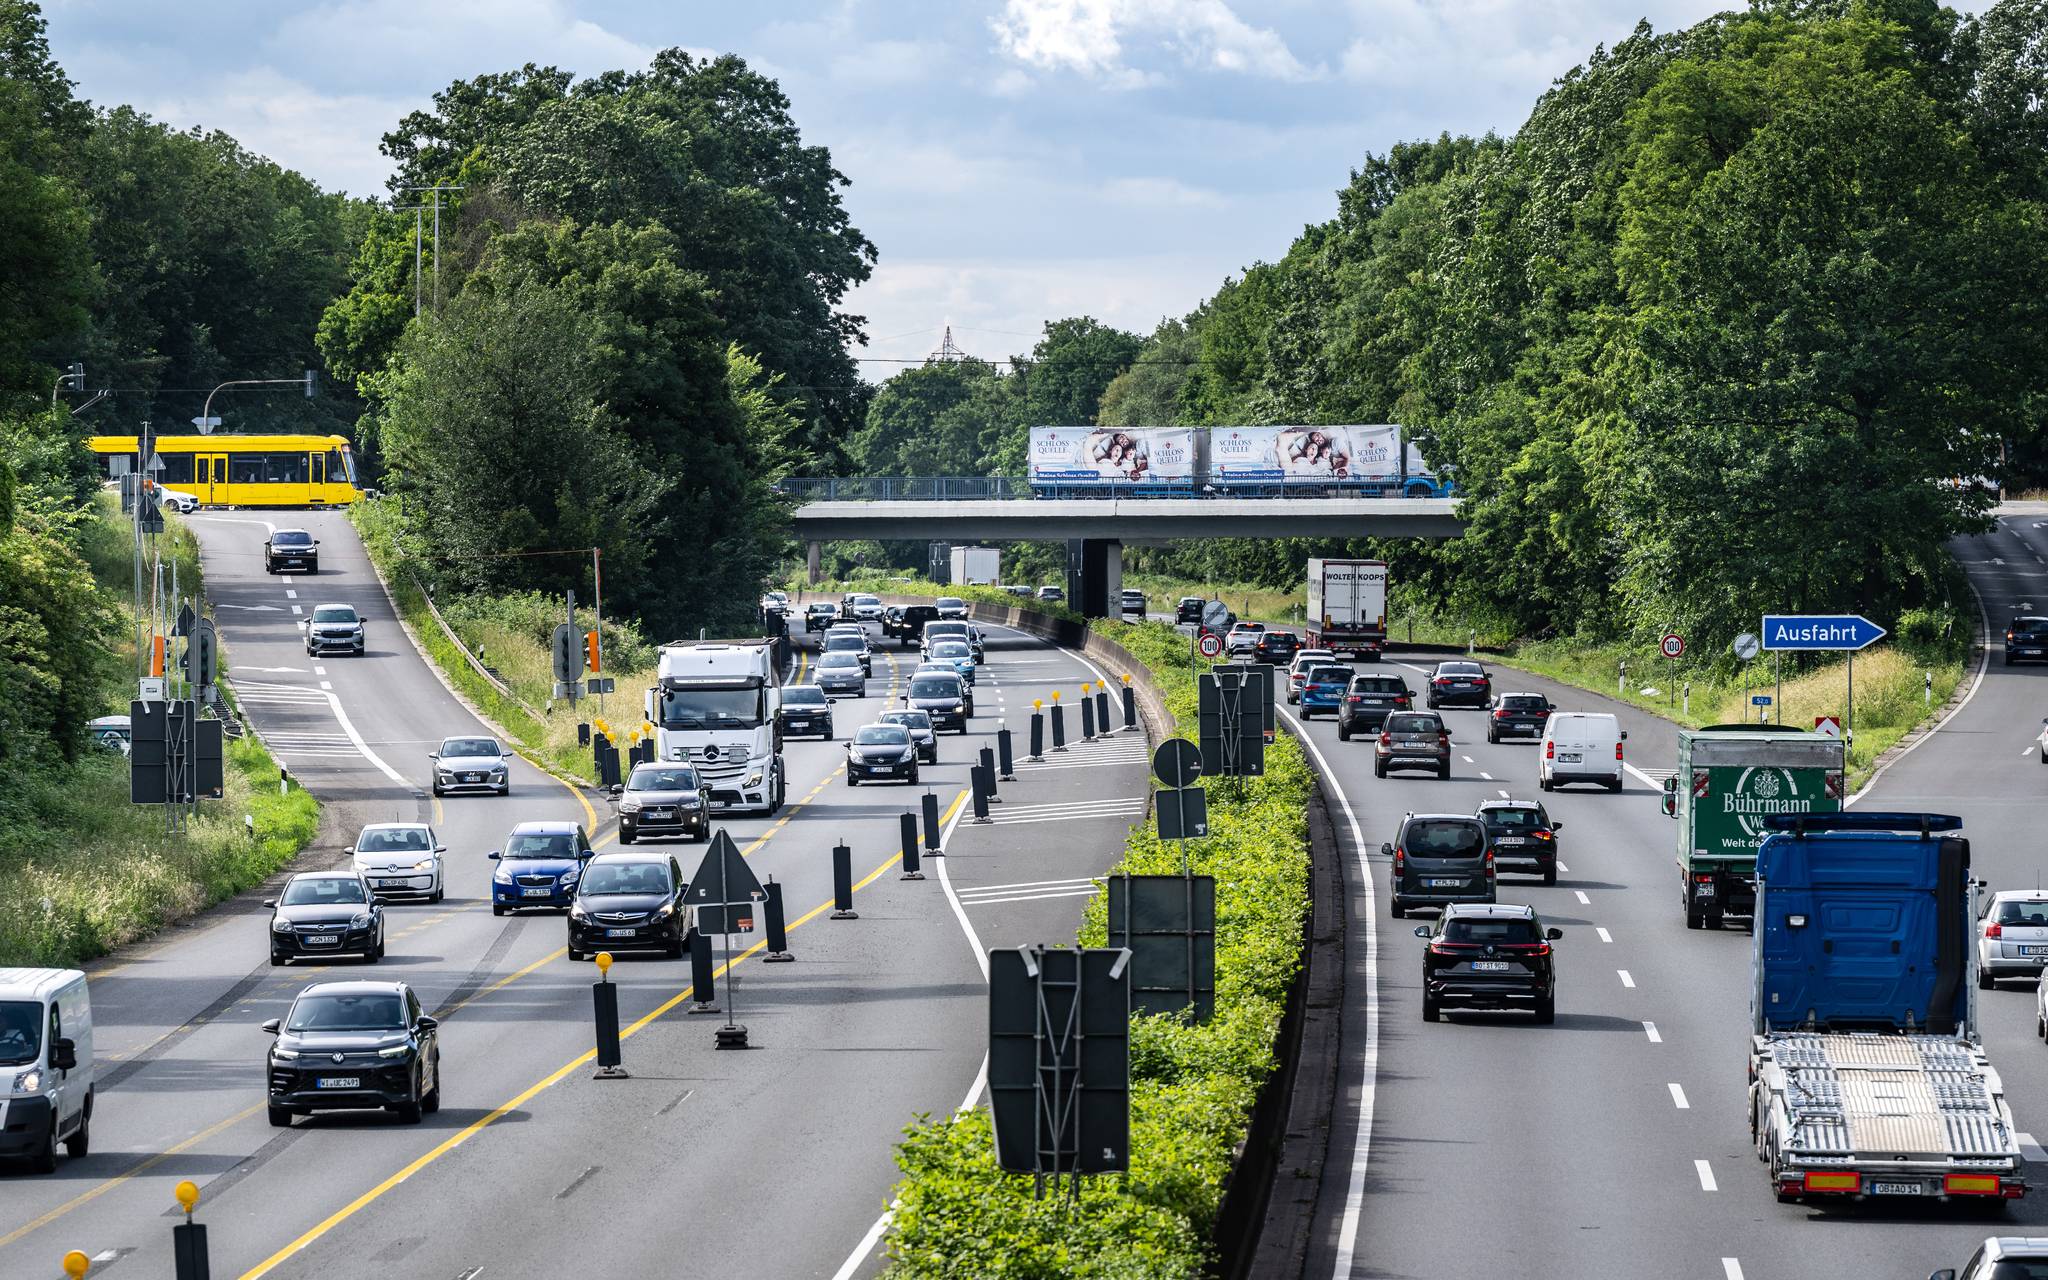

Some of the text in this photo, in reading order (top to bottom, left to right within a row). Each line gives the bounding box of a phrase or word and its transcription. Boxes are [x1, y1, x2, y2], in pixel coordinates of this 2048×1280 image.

[1038, 446, 1067, 454] QUELLE
[1154, 448, 1185, 457] SCHLOSS
[1220, 446, 1250, 454] QUELLE
[1357, 447, 1388, 456] SCHLOSS
[1156, 455, 1182, 464] QUELLE
[1359, 454, 1386, 464] QUELLE
[1358, 573, 1385, 581] KOOPS
[1774, 624, 1857, 641] Ausfahrt
[1203, 640, 1218, 652] 100
[1665, 640, 1680, 652] 100
[1723, 791, 1811, 814] Bührmann
[1721, 838, 1762, 848] Welt de
